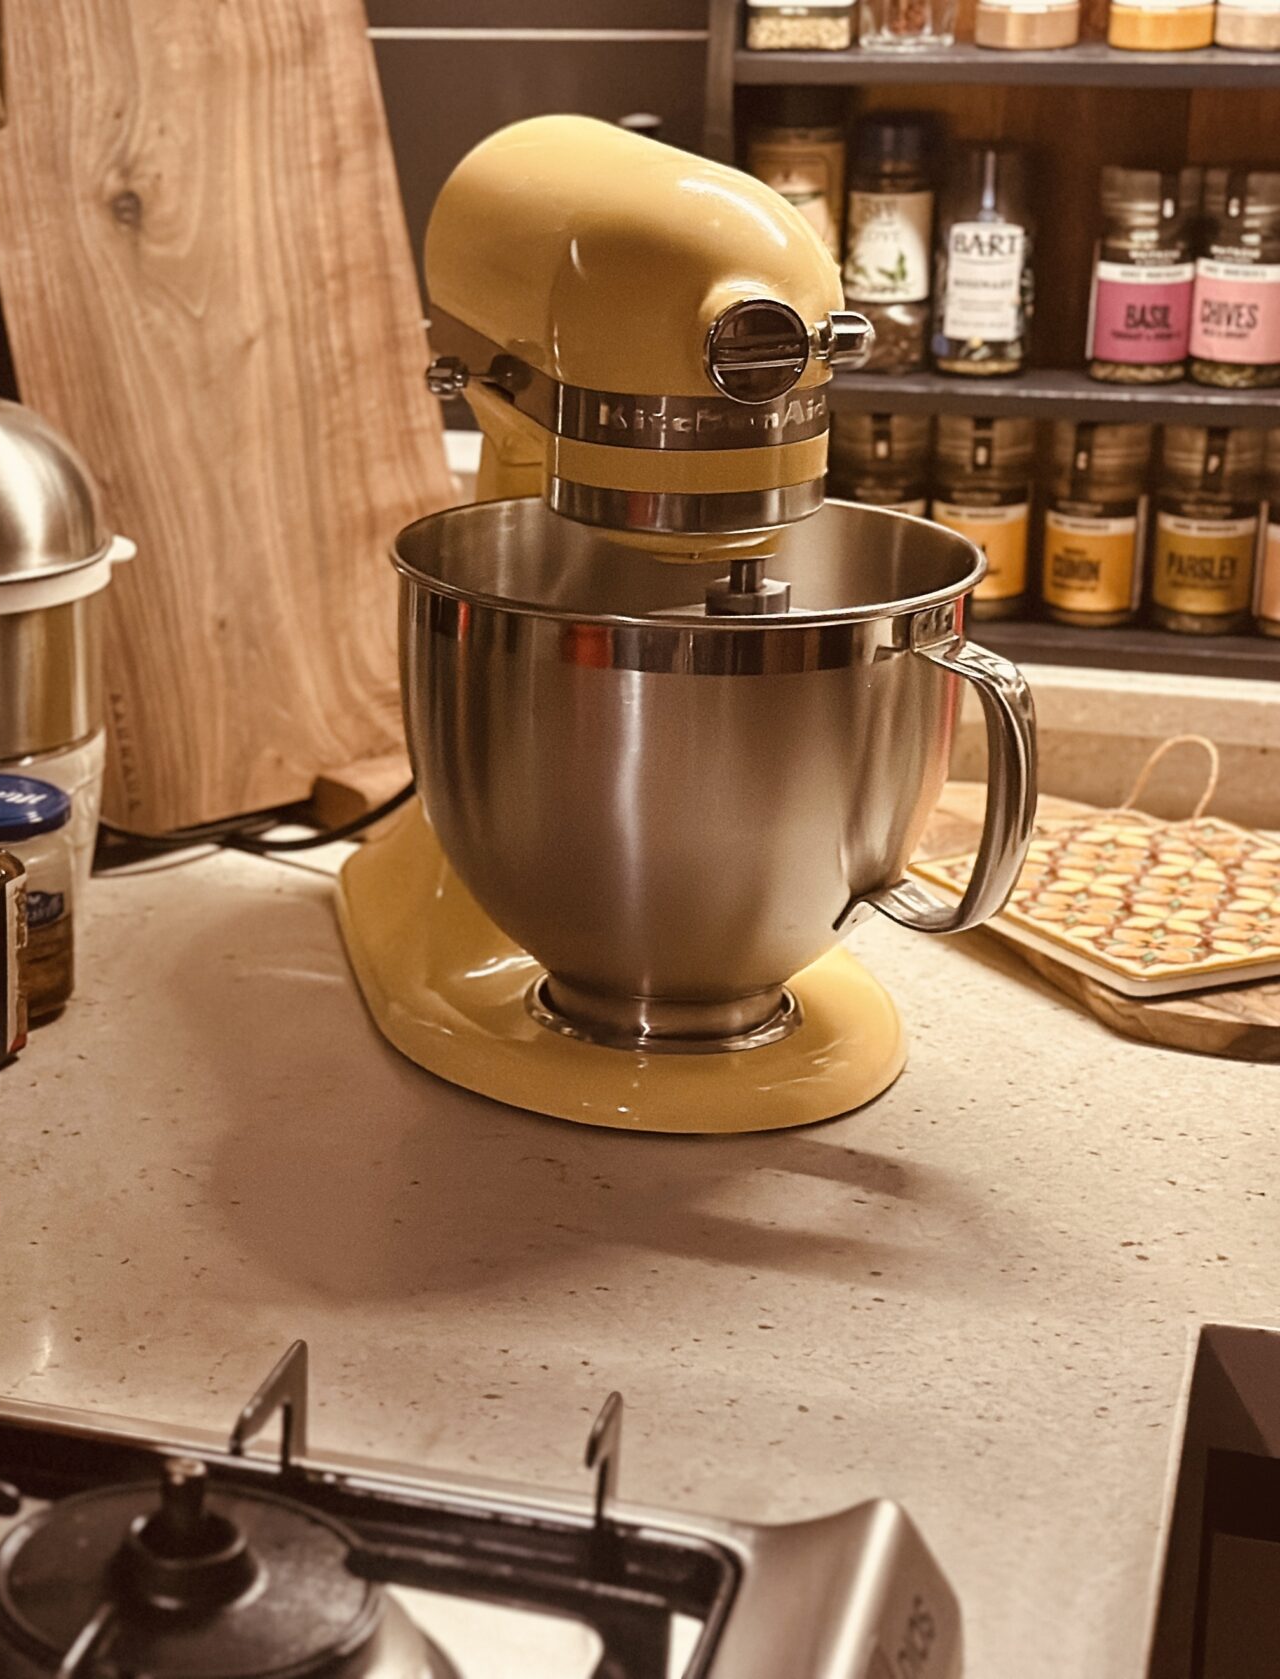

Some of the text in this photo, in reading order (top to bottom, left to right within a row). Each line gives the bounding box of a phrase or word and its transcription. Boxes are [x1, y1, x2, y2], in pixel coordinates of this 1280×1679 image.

[953, 232, 1018, 256] BART
[1125, 303, 1171, 329] BASIL
[1201, 299, 1259, 330] CHIVES
[598, 394, 827, 433] KitchnAid
